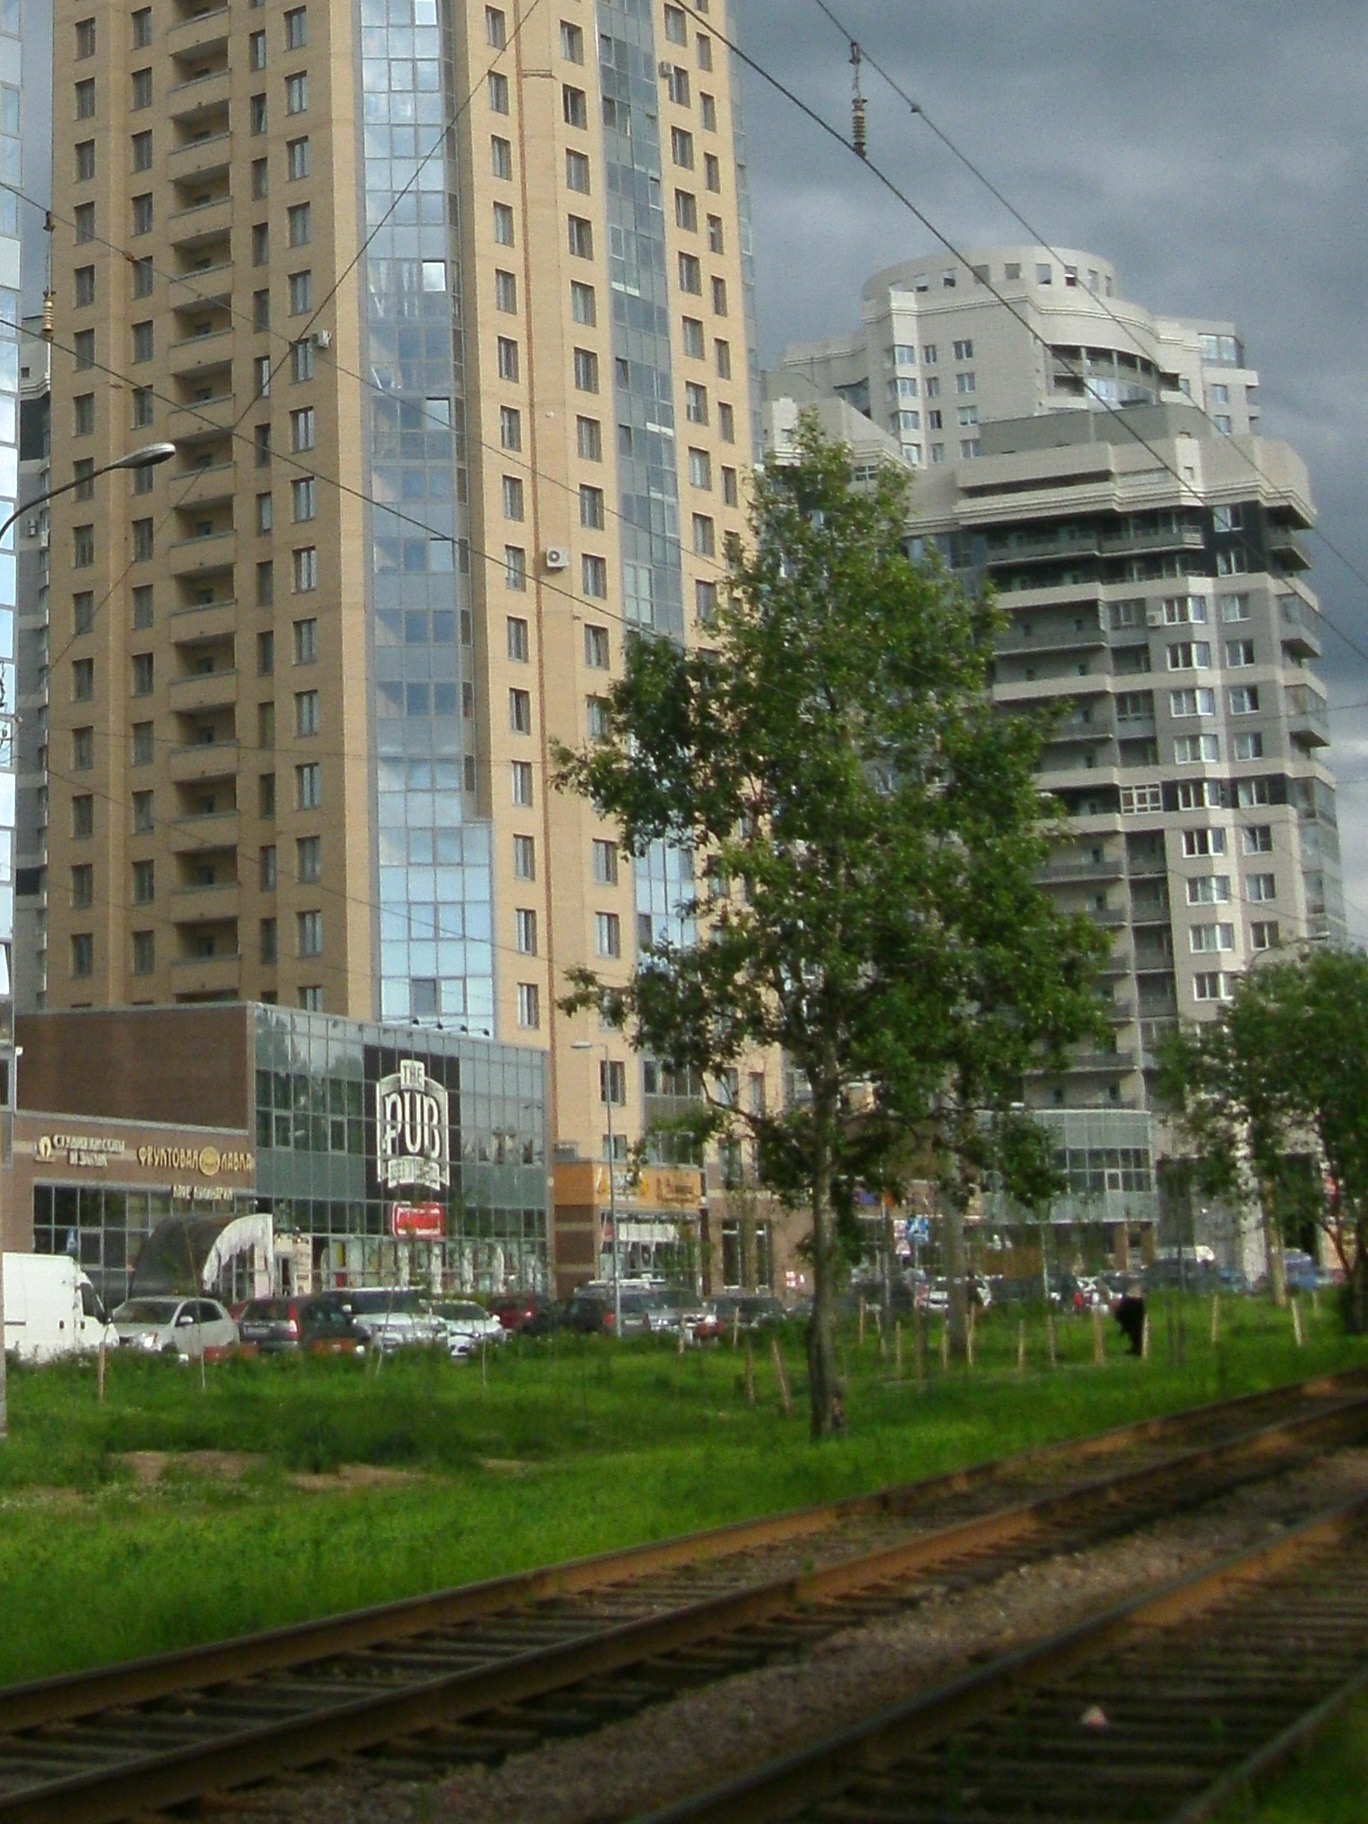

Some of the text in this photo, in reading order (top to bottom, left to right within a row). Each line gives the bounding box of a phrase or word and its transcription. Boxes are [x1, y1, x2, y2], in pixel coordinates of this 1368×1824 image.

[403, 1065, 423, 1085] THE
[384, 1090, 441, 1159] PUB
[138, 1145, 255, 1172] ФРУКТОВАЯ ЛАВКА
